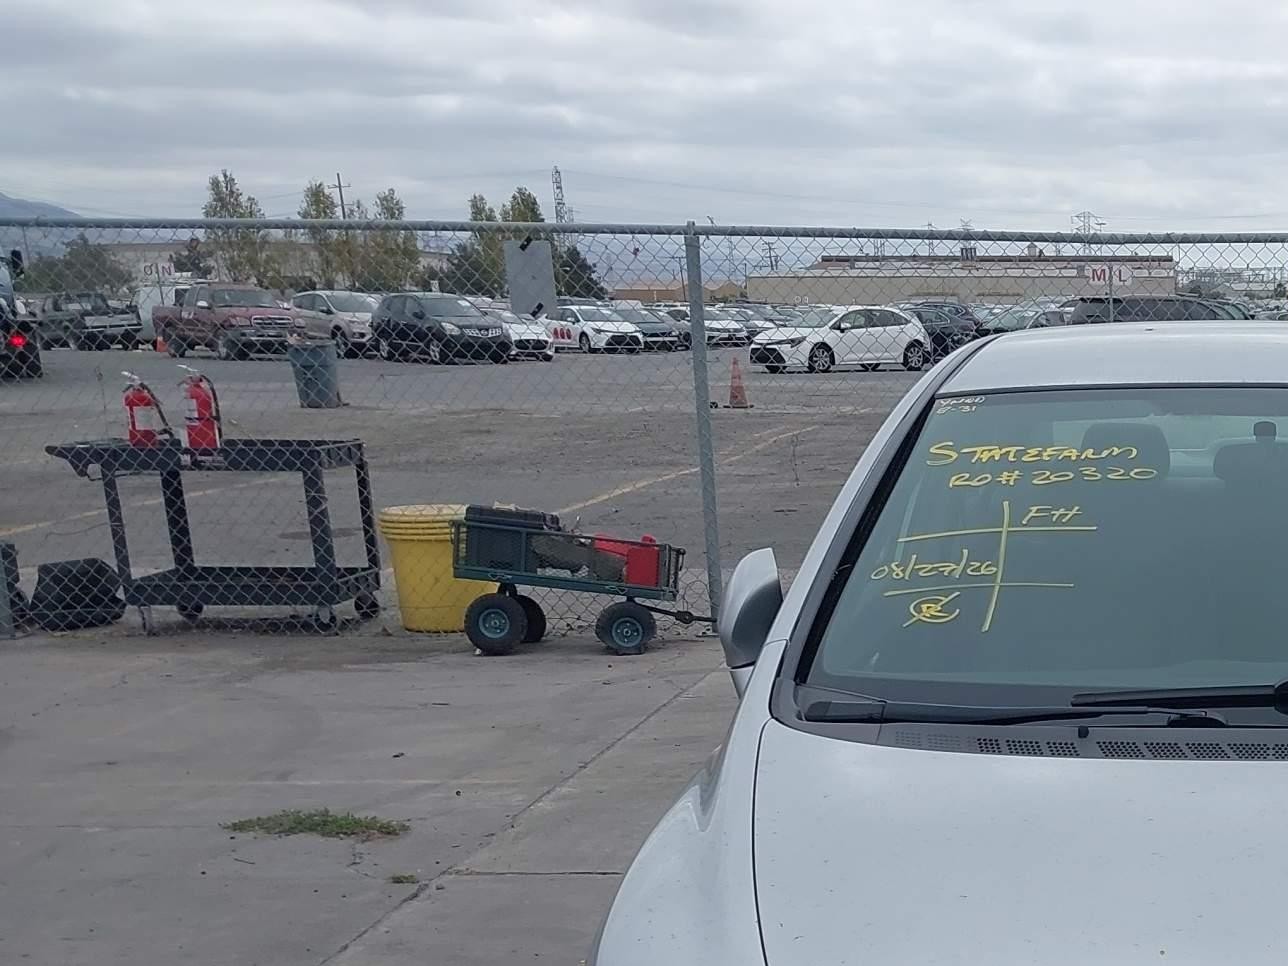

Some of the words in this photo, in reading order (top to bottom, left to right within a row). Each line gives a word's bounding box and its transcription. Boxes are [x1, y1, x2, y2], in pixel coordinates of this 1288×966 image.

[1092, 269, 1106, 281] M
[1118, 269, 1128, 282] L
[871, 549, 998, 580] 08/27/26
